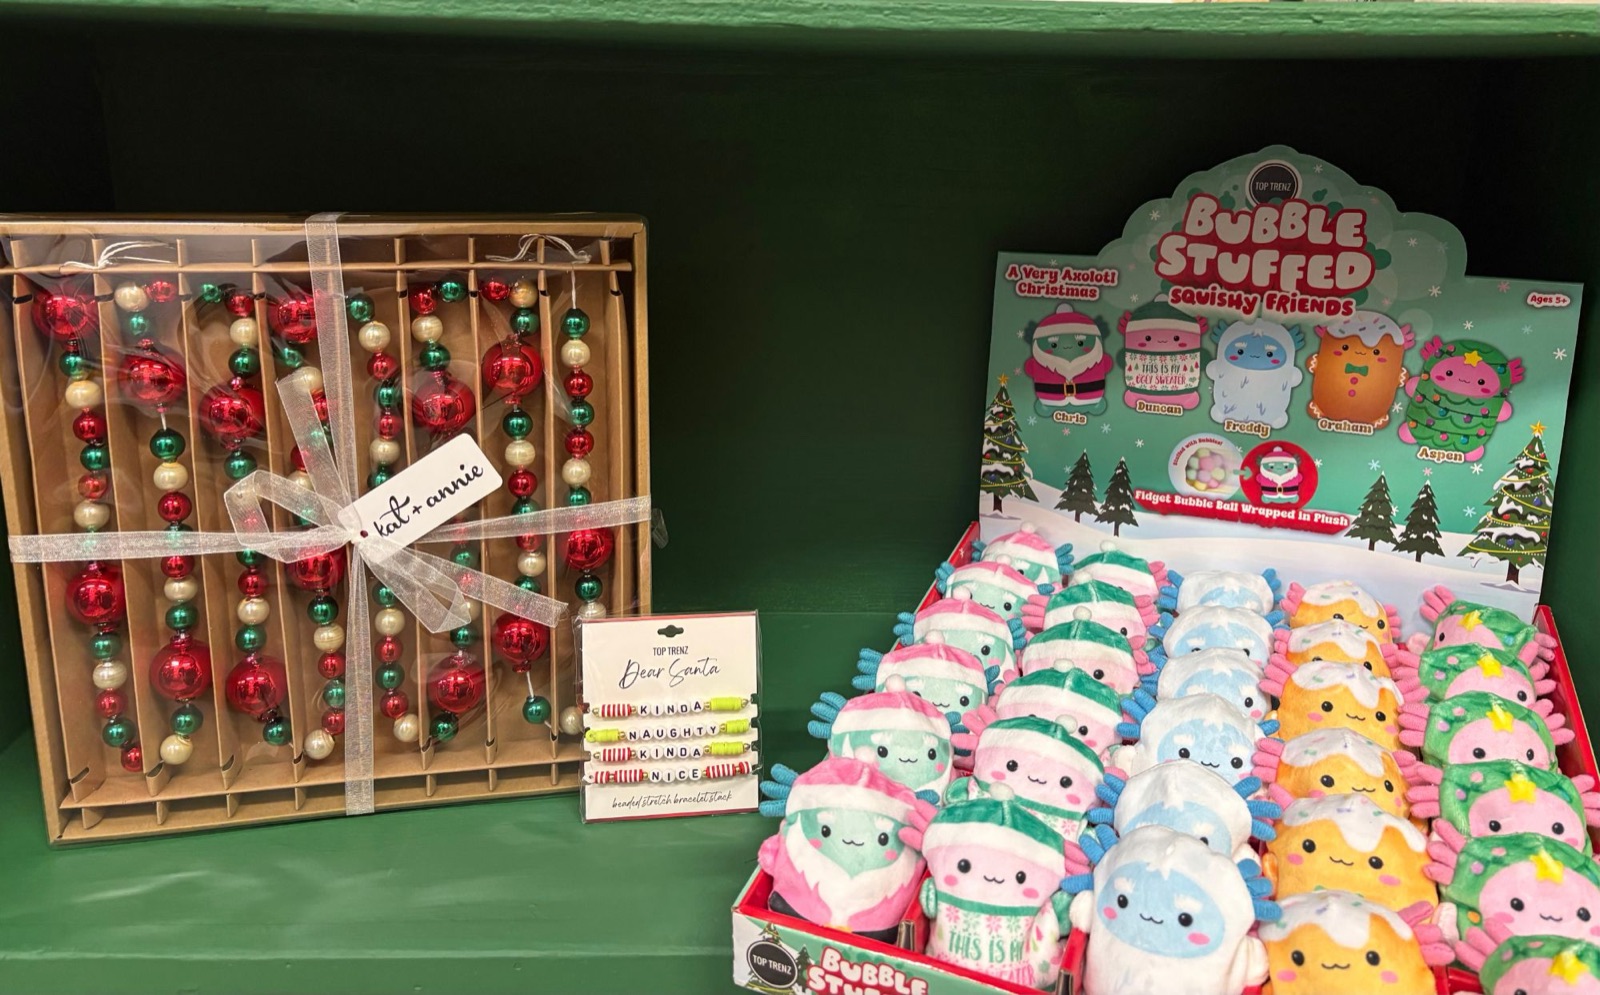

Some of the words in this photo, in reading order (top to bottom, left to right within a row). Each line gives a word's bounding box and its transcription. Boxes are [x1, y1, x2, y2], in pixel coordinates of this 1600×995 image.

[1255, 181, 1269, 191] TOP
[1270, 181, 1292, 192] TRENZ
[1184, 196, 1364, 247] BUBBLE
[1157, 235, 1372, 292] STUFFED
[1007, 266, 1019, 278] A
[1022, 267, 1058, 283] Very
[1062, 268, 1116, 284] Axolotl
[1018, 282, 1098, 298] Christmas
[1530, 295, 1553, 305] Ages
[1555, 296, 1568, 305] 5+
[1142, 364, 1158, 374] THIS
[1161, 364, 1169, 374] IS
[1155, 375, 1187, 385] SWEATER
[1137, 402, 1182, 414] Duncan
[1054, 412, 1086, 424] Chris
[1224, 420, 1270, 437] Freddy
[1319, 419, 1372, 434] Graham
[1419, 447, 1463, 462] Aspen
[373, 495, 410, 537] kat
[412, 505, 422, 515] +
[426, 464, 484, 508] annie
[1135, 490, 1171, 506] Fidget
[1174, 493, 1213, 509] Bubble
[1216, 498, 1238, 512] Ball
[1241, 504, 1295, 521] Wrapped
[1298, 509, 1311, 521] in
[1313, 513, 1348, 526] Plush
[653, 647, 667, 656] TOP
[668, 646, 689, 655] TRENZ
[619, 659, 664, 690] Dear
[668, 657, 721, 688] Santa
[640, 700, 702, 715] KINDA
[629, 725, 718, 740] NAUGHTY
[639, 748, 701, 759] KINDA
[651, 768, 700, 782] NICE
[612, 795, 641, 809] beaded
[642, 793, 672, 806] stretch
[673, 791, 708, 804] bracelet
[709, 789, 732, 802] stack
[948, 930, 982, 961] THIS
[989, 938, 1006, 963] IS
[752, 954, 767, 967] TOP
[768, 957, 792, 975] TRENZ
[822, 947, 928, 995] BUBBLE
